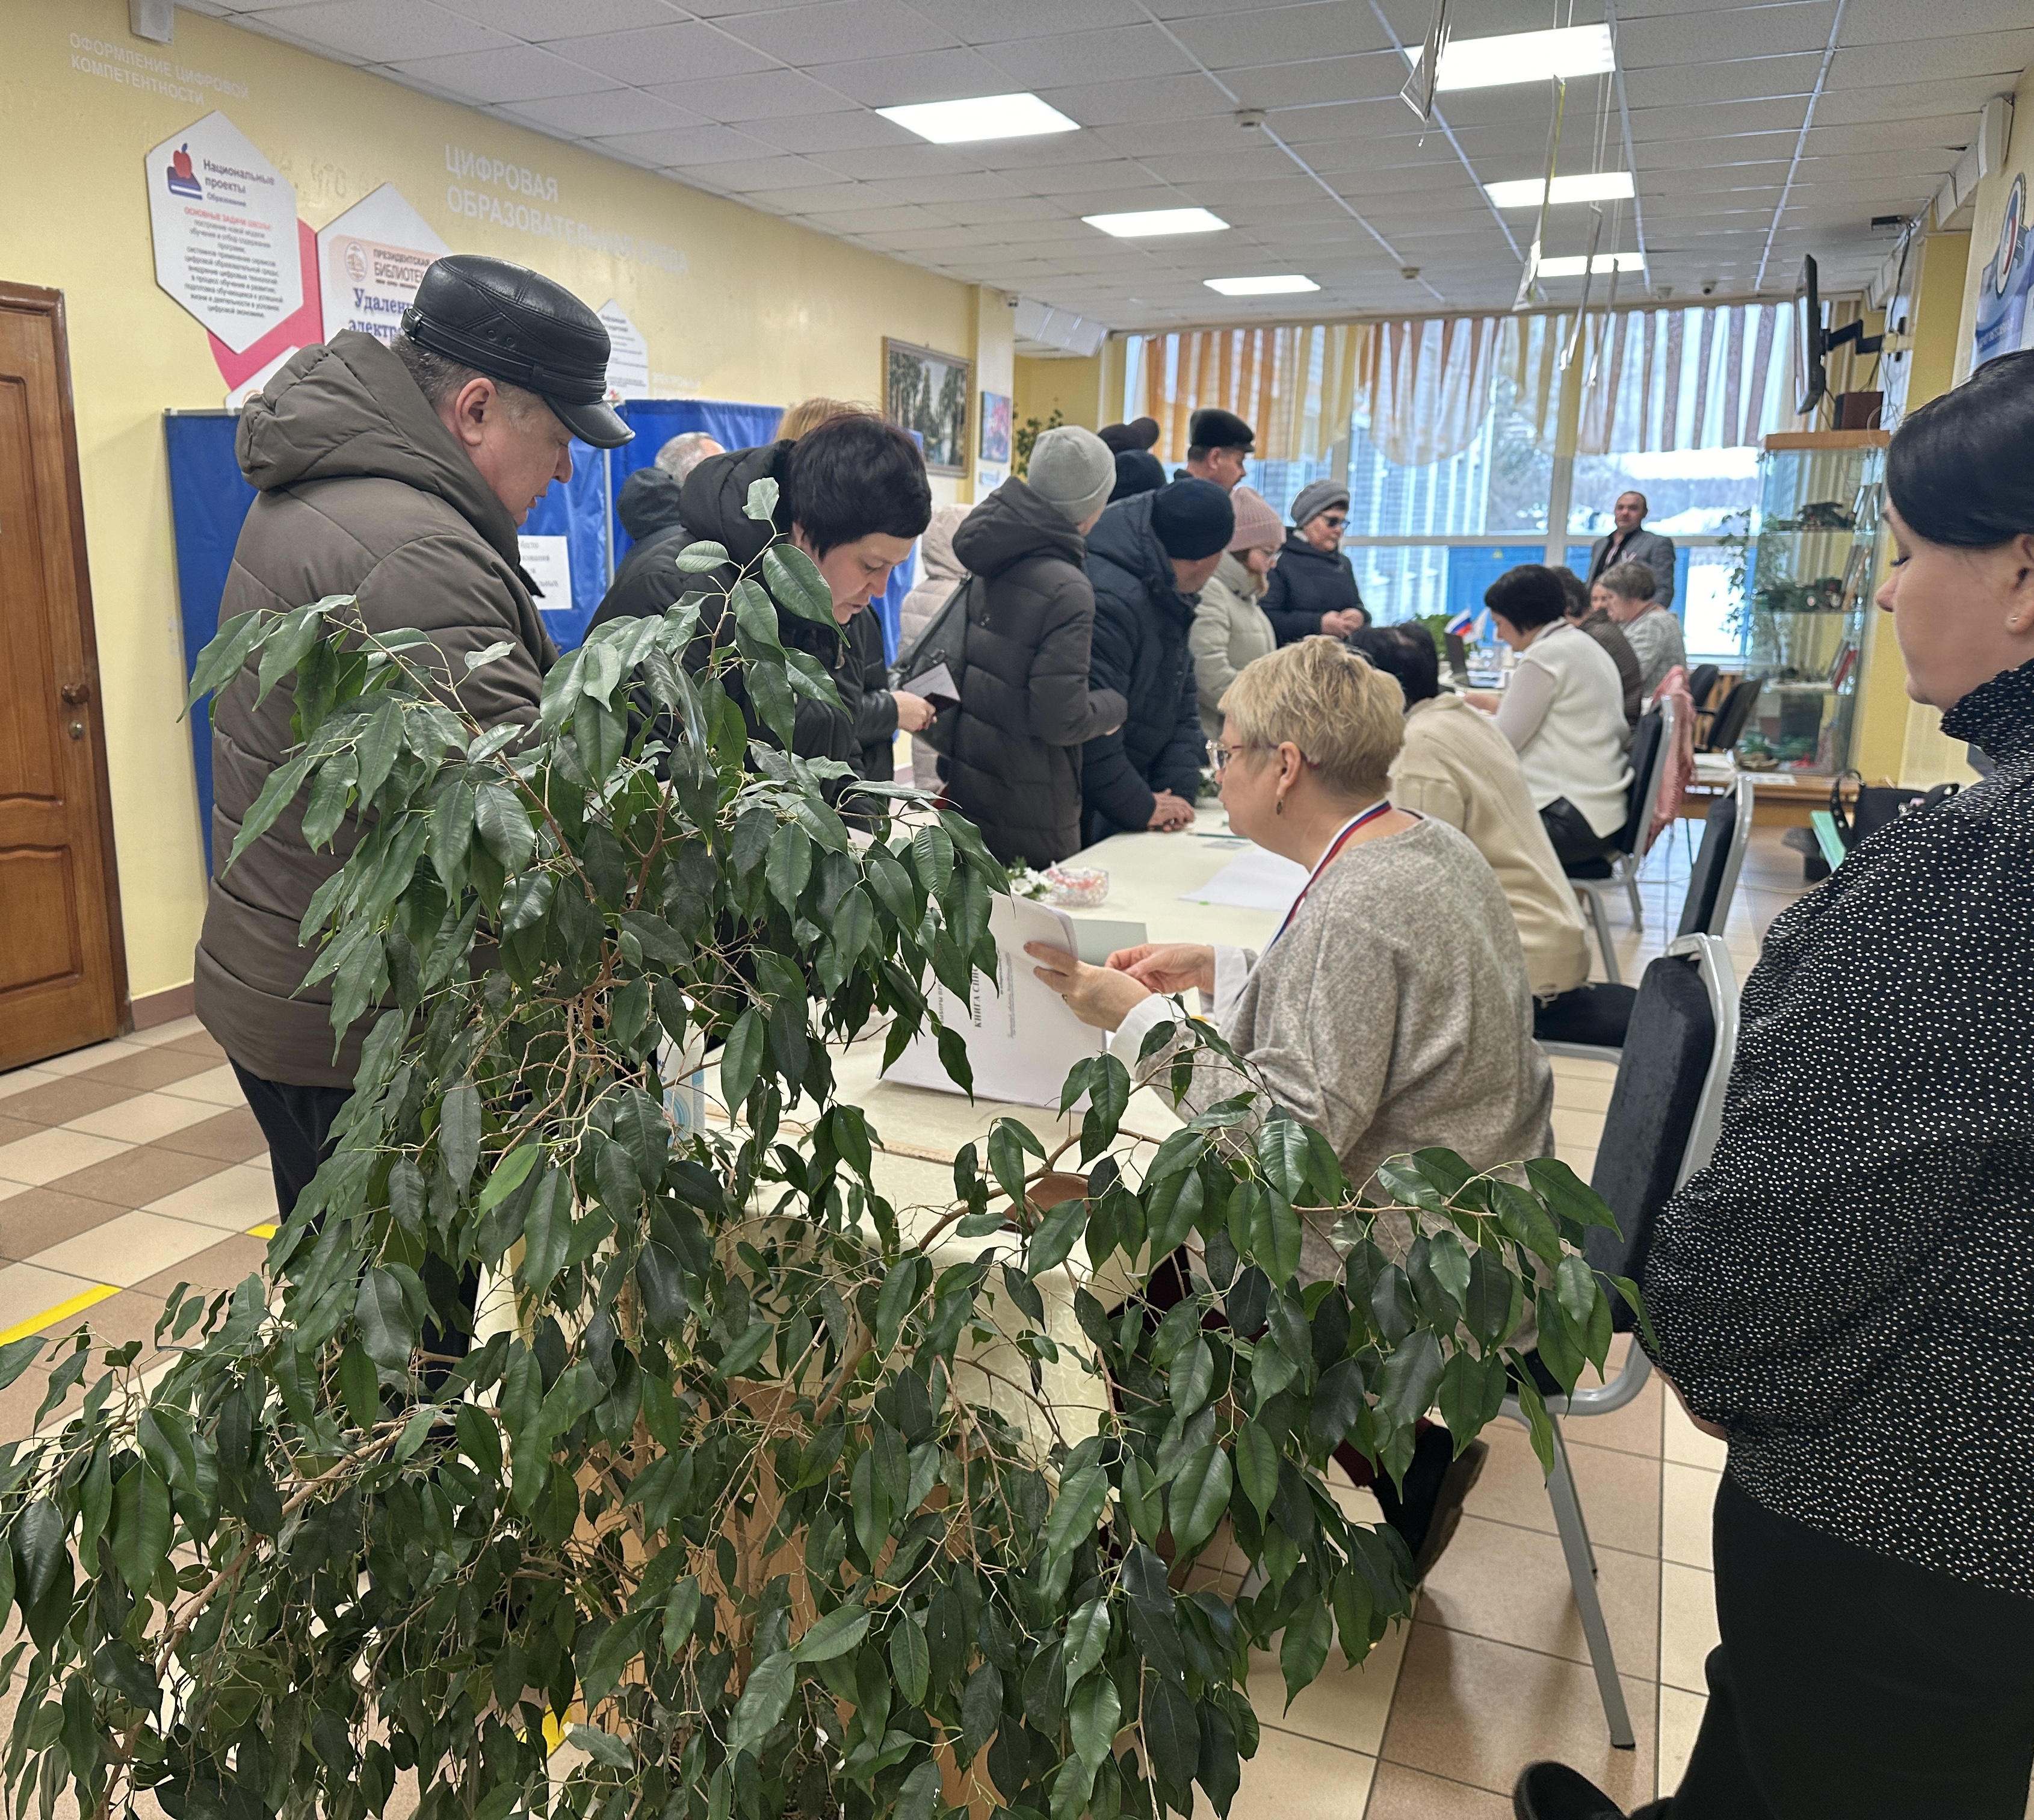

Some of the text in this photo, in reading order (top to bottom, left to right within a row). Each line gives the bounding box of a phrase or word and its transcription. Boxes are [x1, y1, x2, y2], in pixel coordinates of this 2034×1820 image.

[70, 32, 249, 99] ОФОРМЛЕНИЕ ЦИФРОВОЙ
[71, 54, 205, 106] КОМПЕТЕНТНОСТИ
[203, 159, 274, 185] Национальные
[205, 176, 247, 194] проекты
[445, 144, 559, 203] ЦИФРОВАЯ
[447, 185, 634, 258] ОБРАЗОВАТЕЛЬНАЯ
[973, 995, 981, 1028] КНИГА
